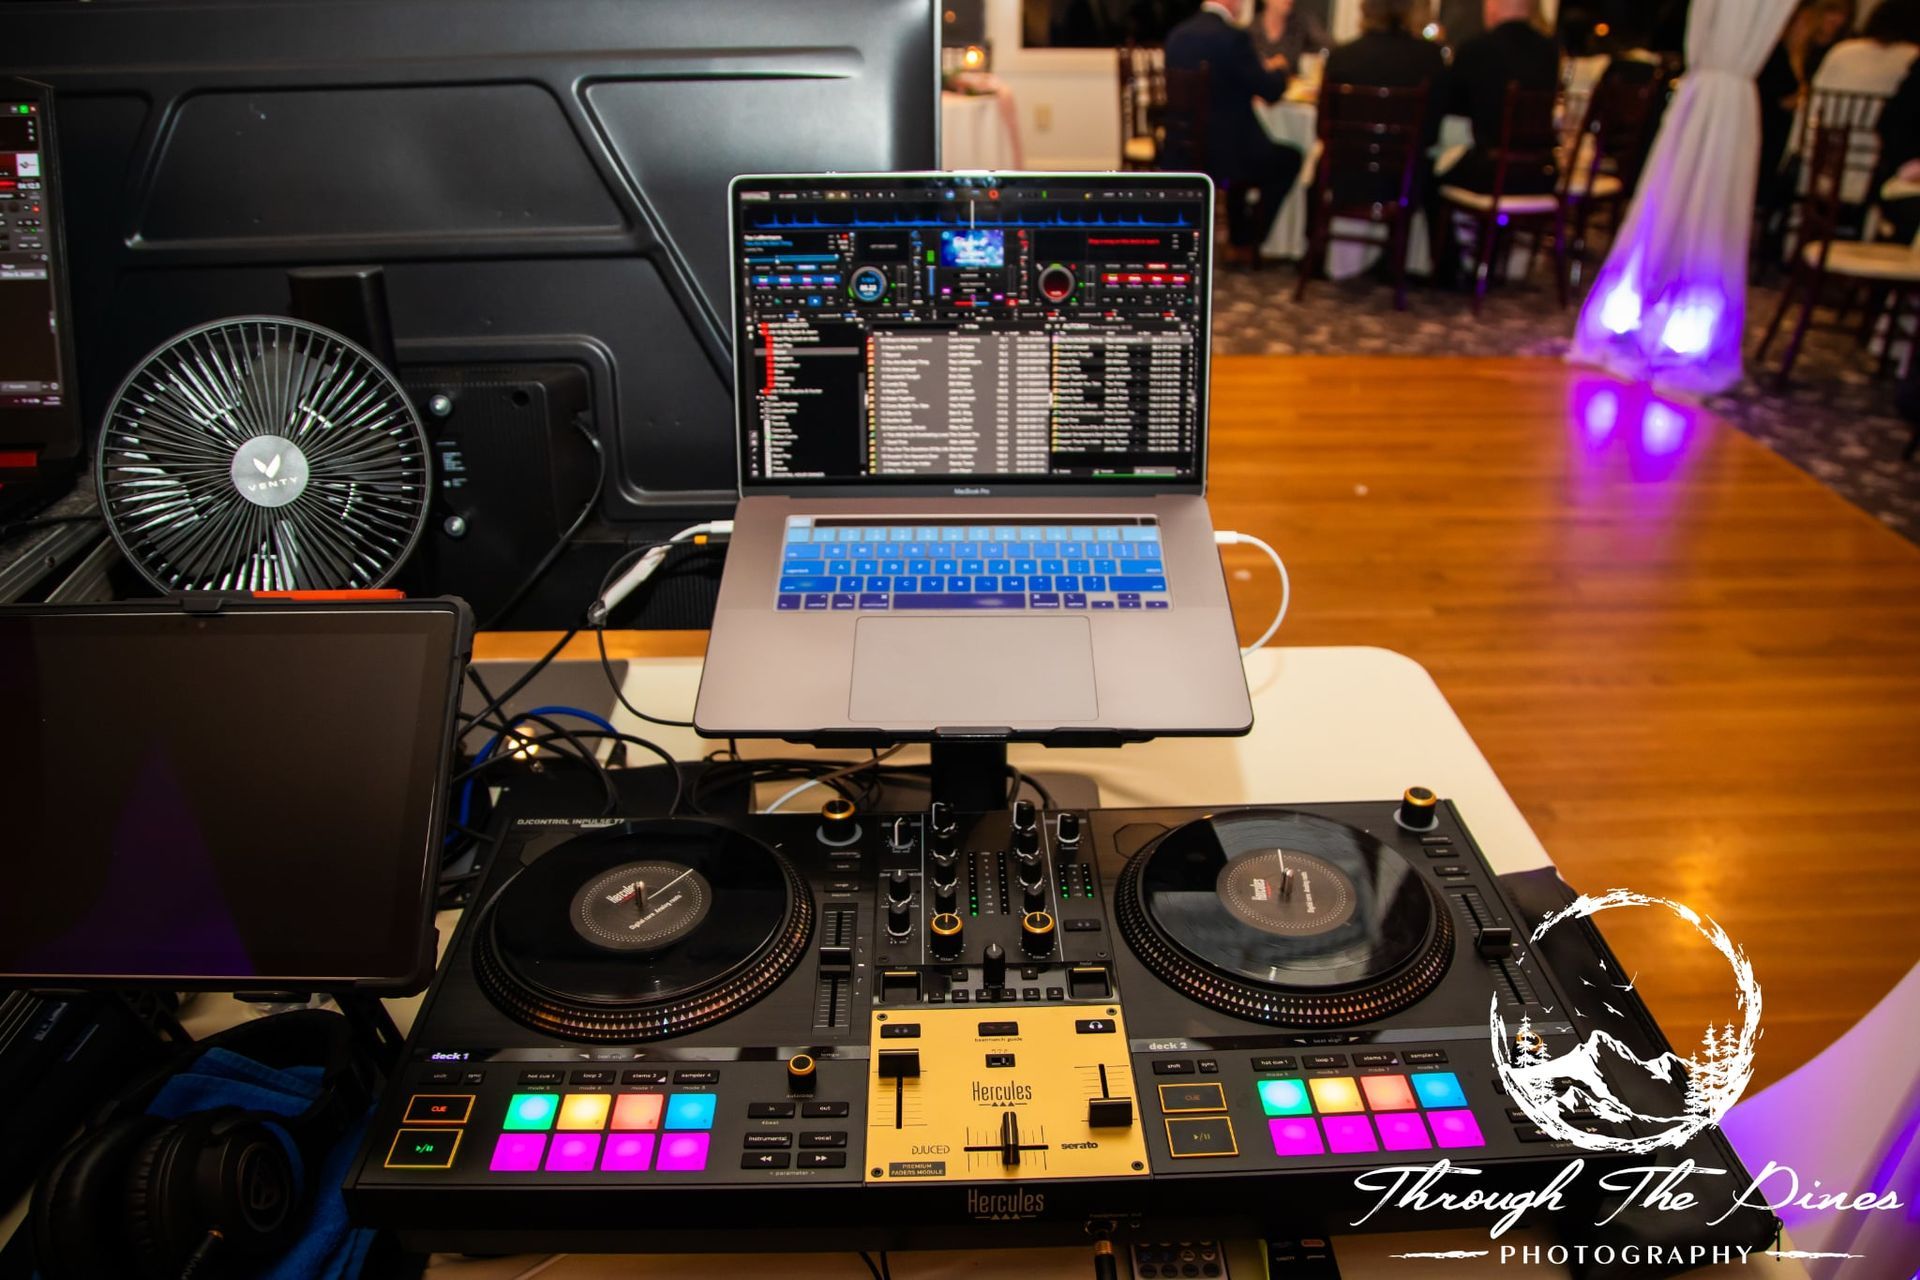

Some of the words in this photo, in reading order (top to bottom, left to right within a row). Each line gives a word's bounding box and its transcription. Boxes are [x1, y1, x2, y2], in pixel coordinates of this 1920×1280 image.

[248, 477, 297, 491] VENTY
[1249, 877, 1268, 901] Hercules
[1149, 1042, 1177, 1050] deck
[432, 1052, 461, 1060] deck
[462, 1052, 469, 1060] 1
[972, 1080, 1032, 1101] Hercules
[911, 1145, 950, 1155] DJUCED
[1060, 1141, 1098, 1150] serato
[968, 1187, 1045, 1213] Hercules
